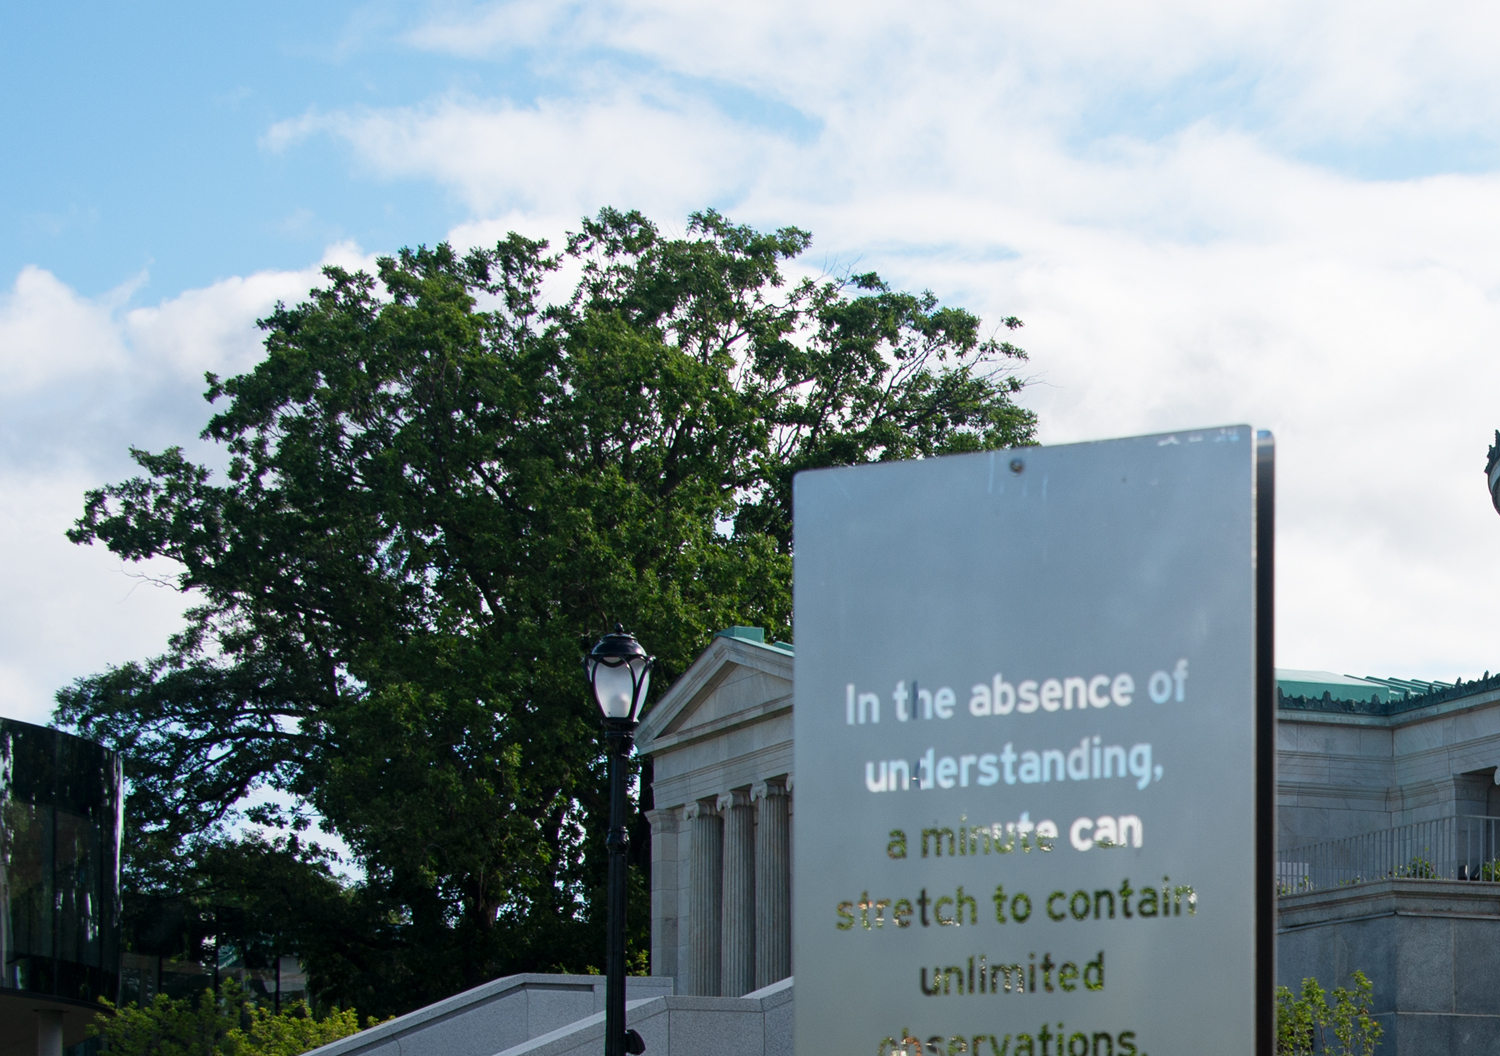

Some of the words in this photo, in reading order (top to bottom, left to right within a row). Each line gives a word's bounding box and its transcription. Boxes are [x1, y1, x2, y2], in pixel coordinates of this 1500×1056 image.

[846, 684, 879, 725] In
[893, 680, 955, 720] the
[969, 673, 1134, 717] absence
[1148, 658, 1189, 704] of
[865, 736, 1163, 792] understanding,
[887, 827, 907, 859] a
[920, 812, 1058, 858] minute
[1070, 814, 1143, 851] can
[836, 887, 977, 931] stretch
[993, 885, 1031, 924] to
[1047, 876, 1198, 922] contain
[920, 951, 1104, 996] unlimited
